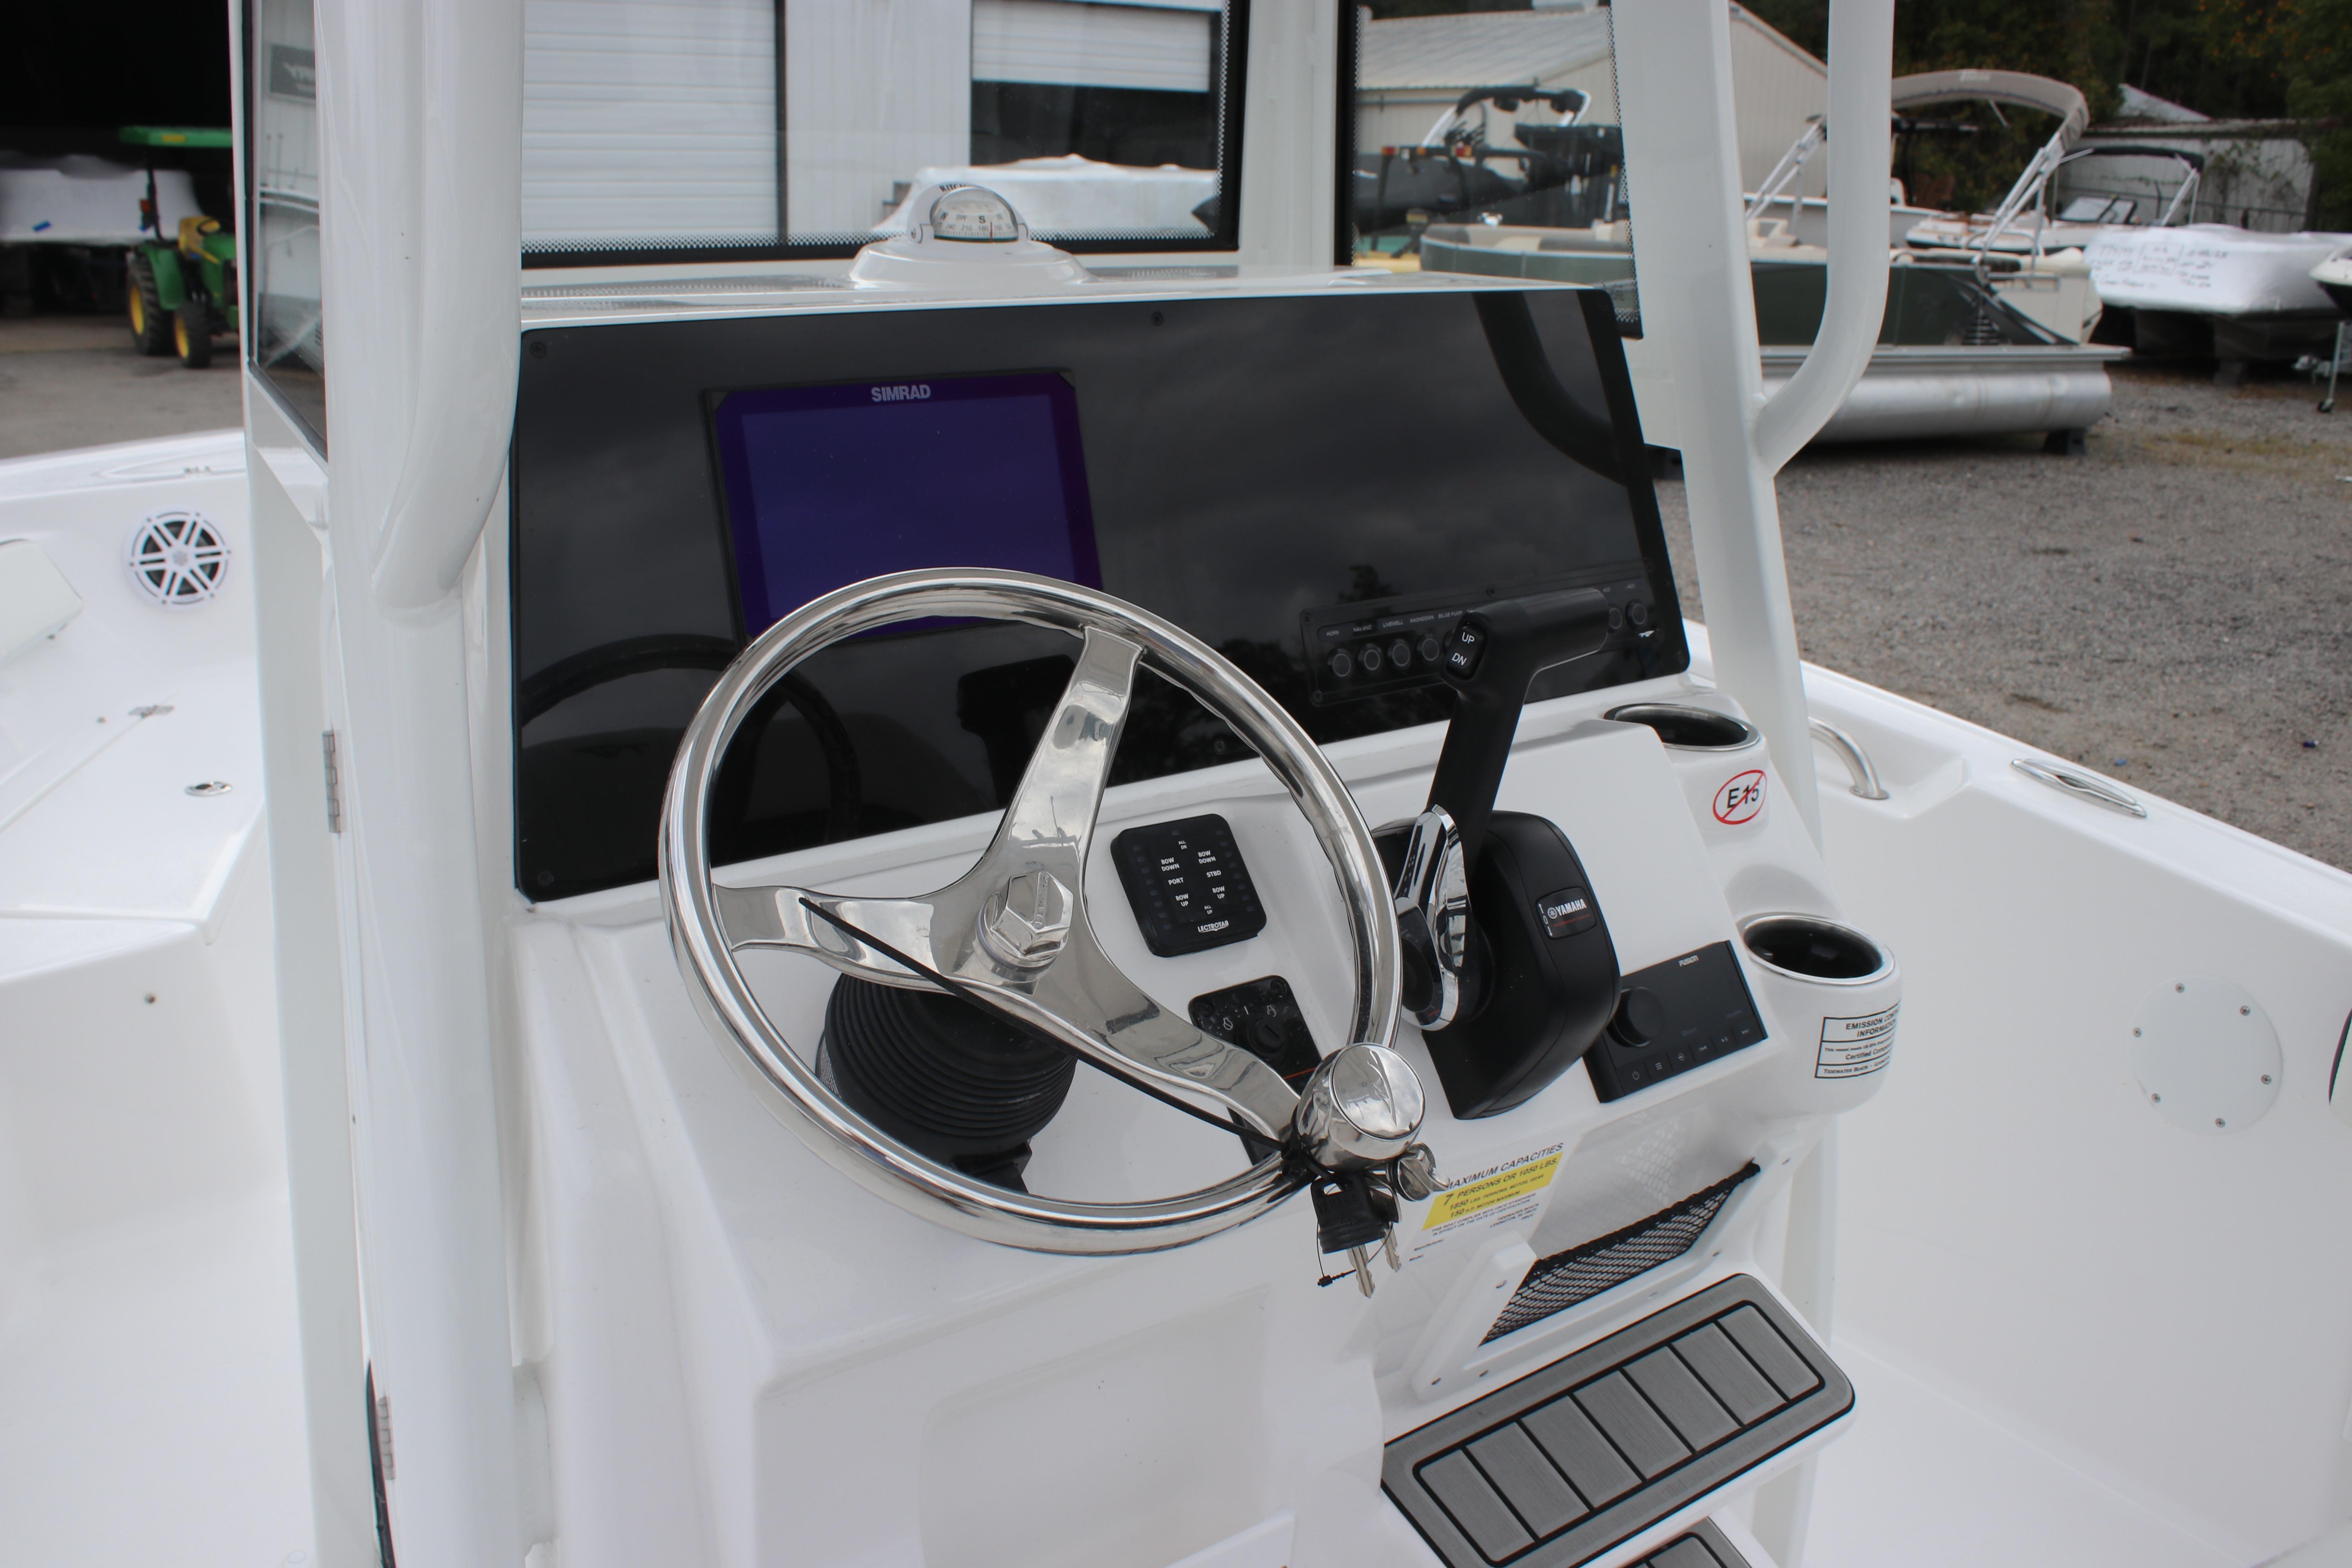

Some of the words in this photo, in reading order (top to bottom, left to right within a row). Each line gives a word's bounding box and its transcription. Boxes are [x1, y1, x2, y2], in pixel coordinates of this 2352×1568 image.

[979, 215, 985, 223] S
[871, 384, 931, 402] SIMRAD
[1383, 619, 1403, 627] LIVEWELL
[1462, 632, 1475, 644] UP
[1452, 652, 1467, 665] DN
[1161, 863, 1180, 871] DOWN
[1555, 898, 1587, 916] YAMAHA
[1198, 920, 1229, 932] LECTROTAB
[1679, 955, 1699, 967] FUSION
[1846, 1018, 1883, 1030] EMISSION
[1846, 1051, 1871, 1060] Certified
[1500, 1143, 1563, 1171] CAPACITIES
[1442, 1193, 1453, 1205] 7
[1457, 1178, 1501, 1198] PERSONS
[1503, 1172, 1516, 1182] OR
[1519, 1165, 1537, 1176] 1050
[1539, 1157, 1558, 1169] LBS.
[1449, 1199, 1468, 1210] 1850
[1450, 1208, 1464, 1218] 150
[1476, 1199, 1495, 1208] MOTOR
[1496, 1190, 1519, 1201] MAXIMUM
